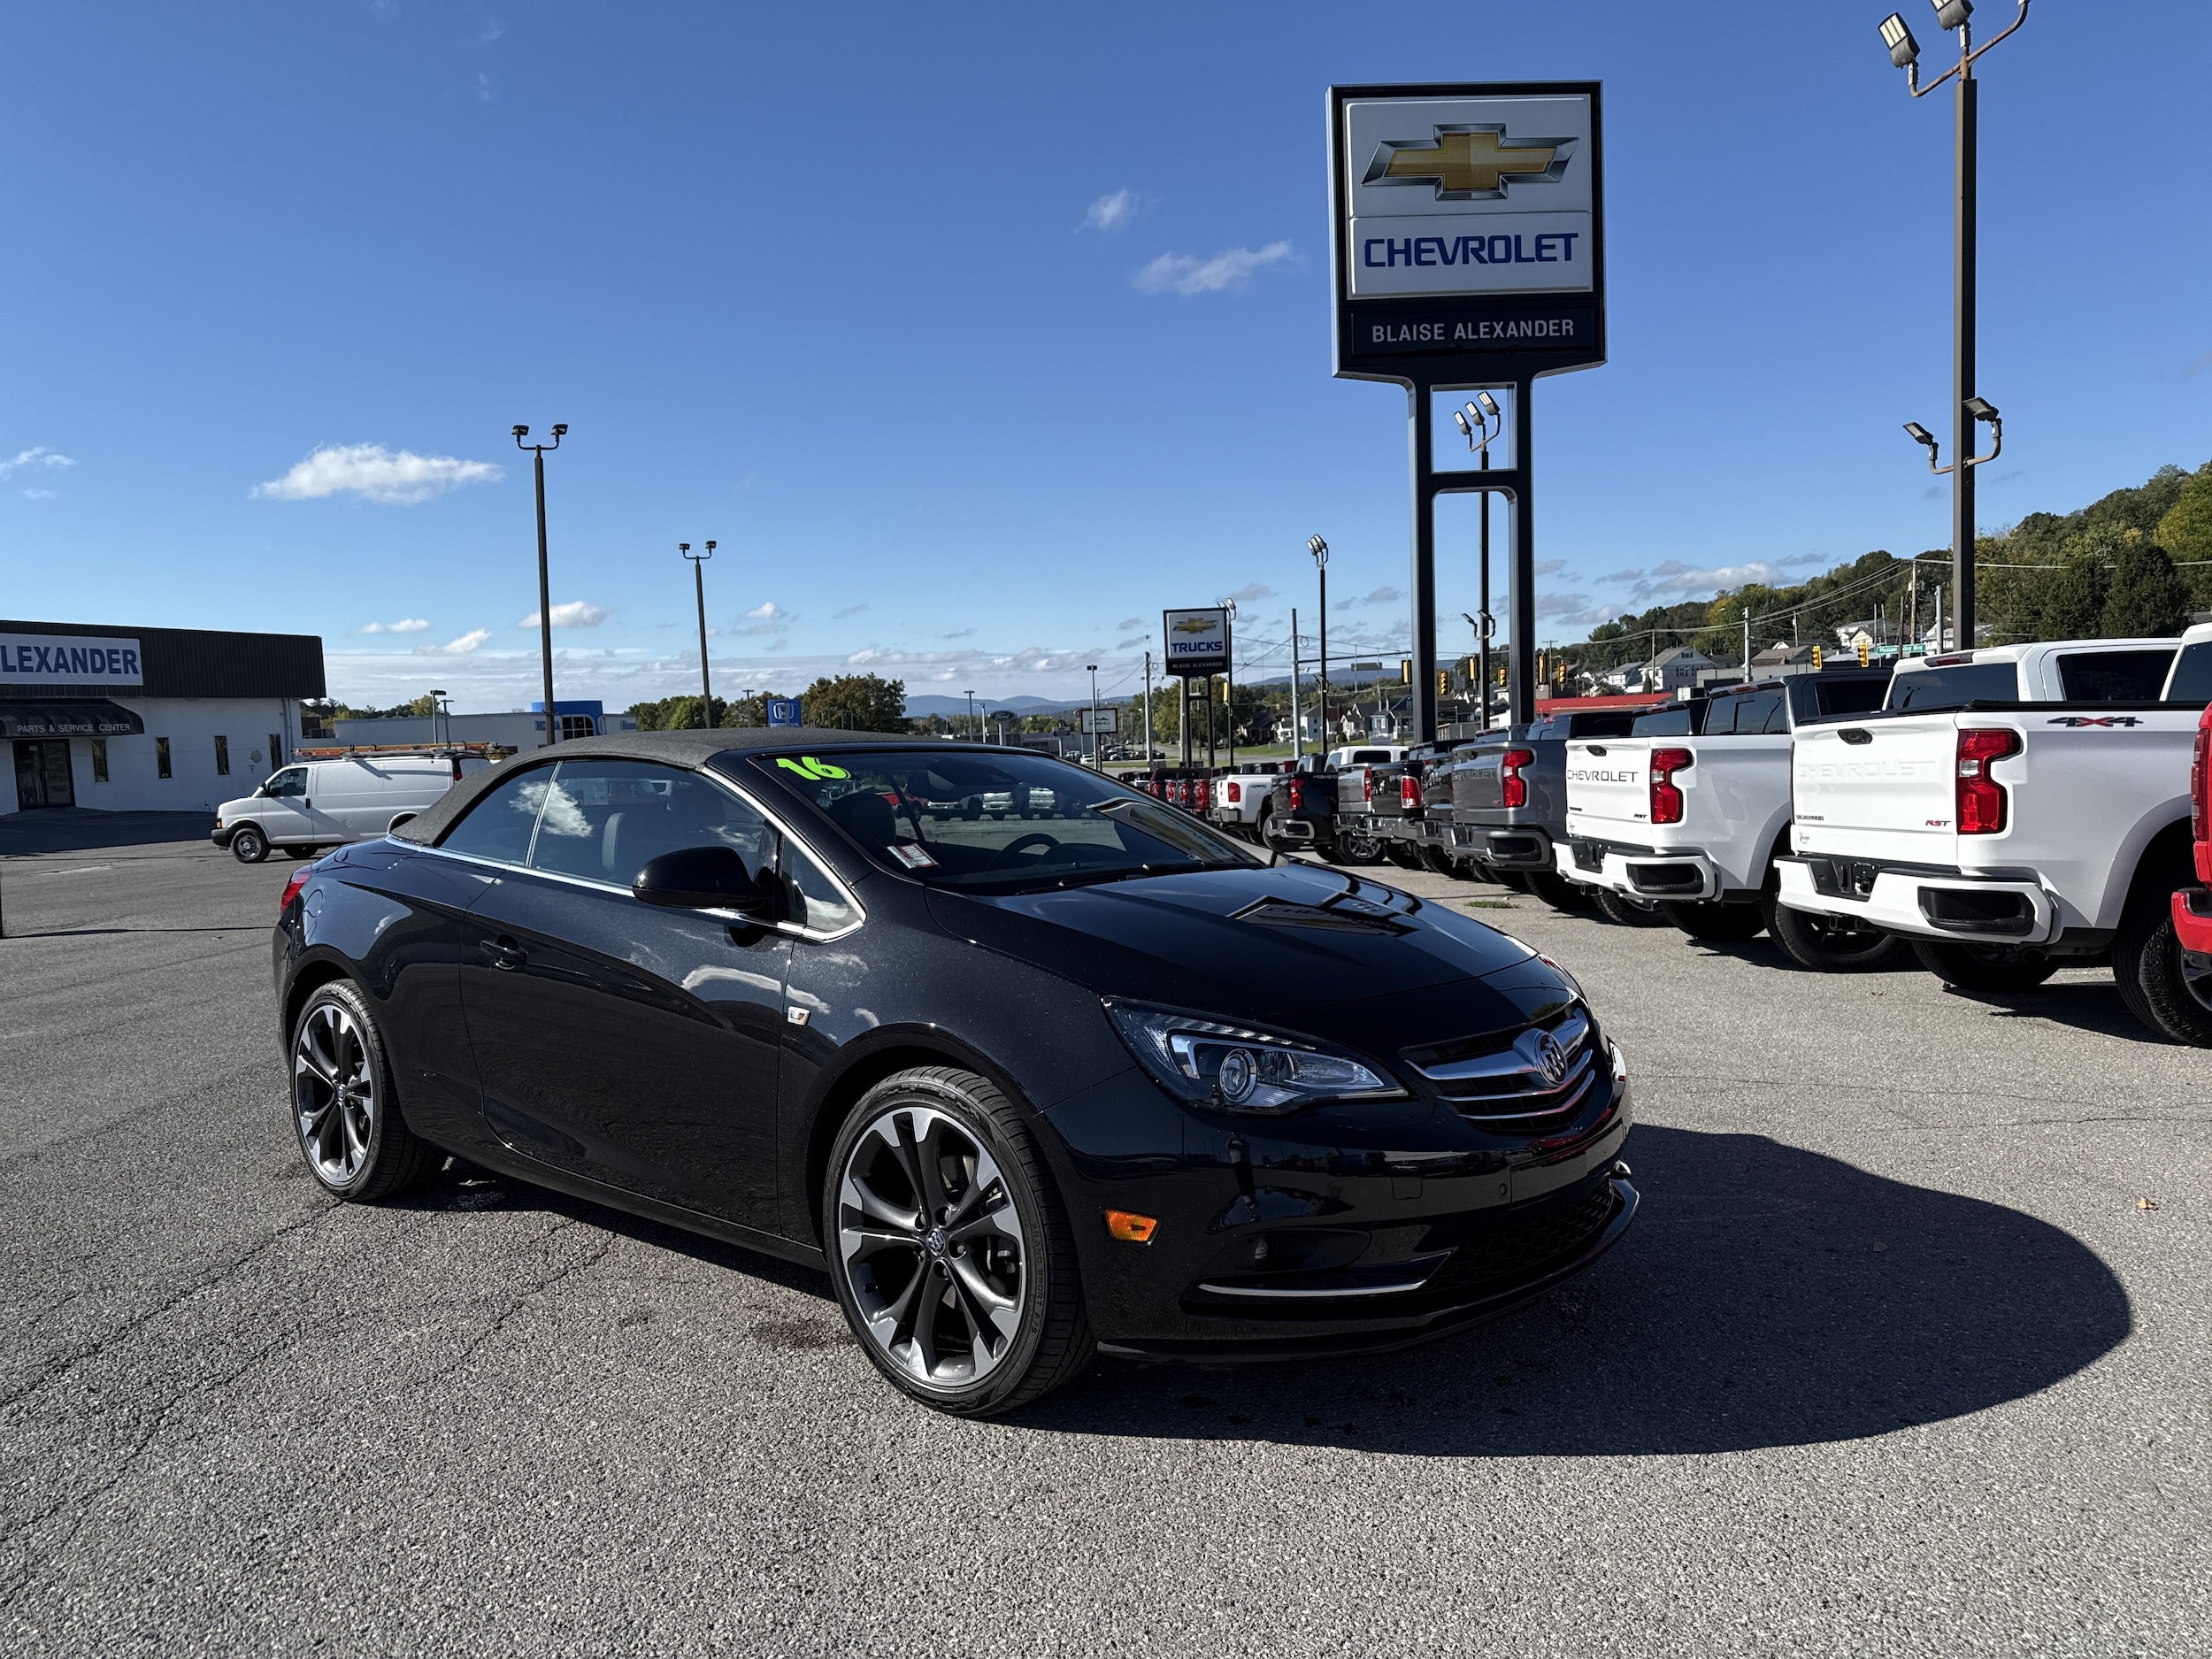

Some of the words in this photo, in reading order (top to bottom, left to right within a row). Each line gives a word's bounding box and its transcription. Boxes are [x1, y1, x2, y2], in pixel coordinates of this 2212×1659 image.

[1364, 233, 1578, 267] CHEVROLET
[1372, 323, 1445, 342] BLAISE
[1454, 319, 1574, 340] ALEXANDER
[1171, 641, 1223, 653] TRUCKS
[0, 645, 139, 674] LEXANDER
[17, 725, 45, 733] PARTS
[49, 724, 55, 733] &
[58, 724, 94, 733] SERVICE
[99, 723, 131, 732] CENTER
[775, 757, 852, 780] 16
[1567, 770, 1639, 782] CHEVROLET
[1035, 1269, 1044, 1307] SPORT
